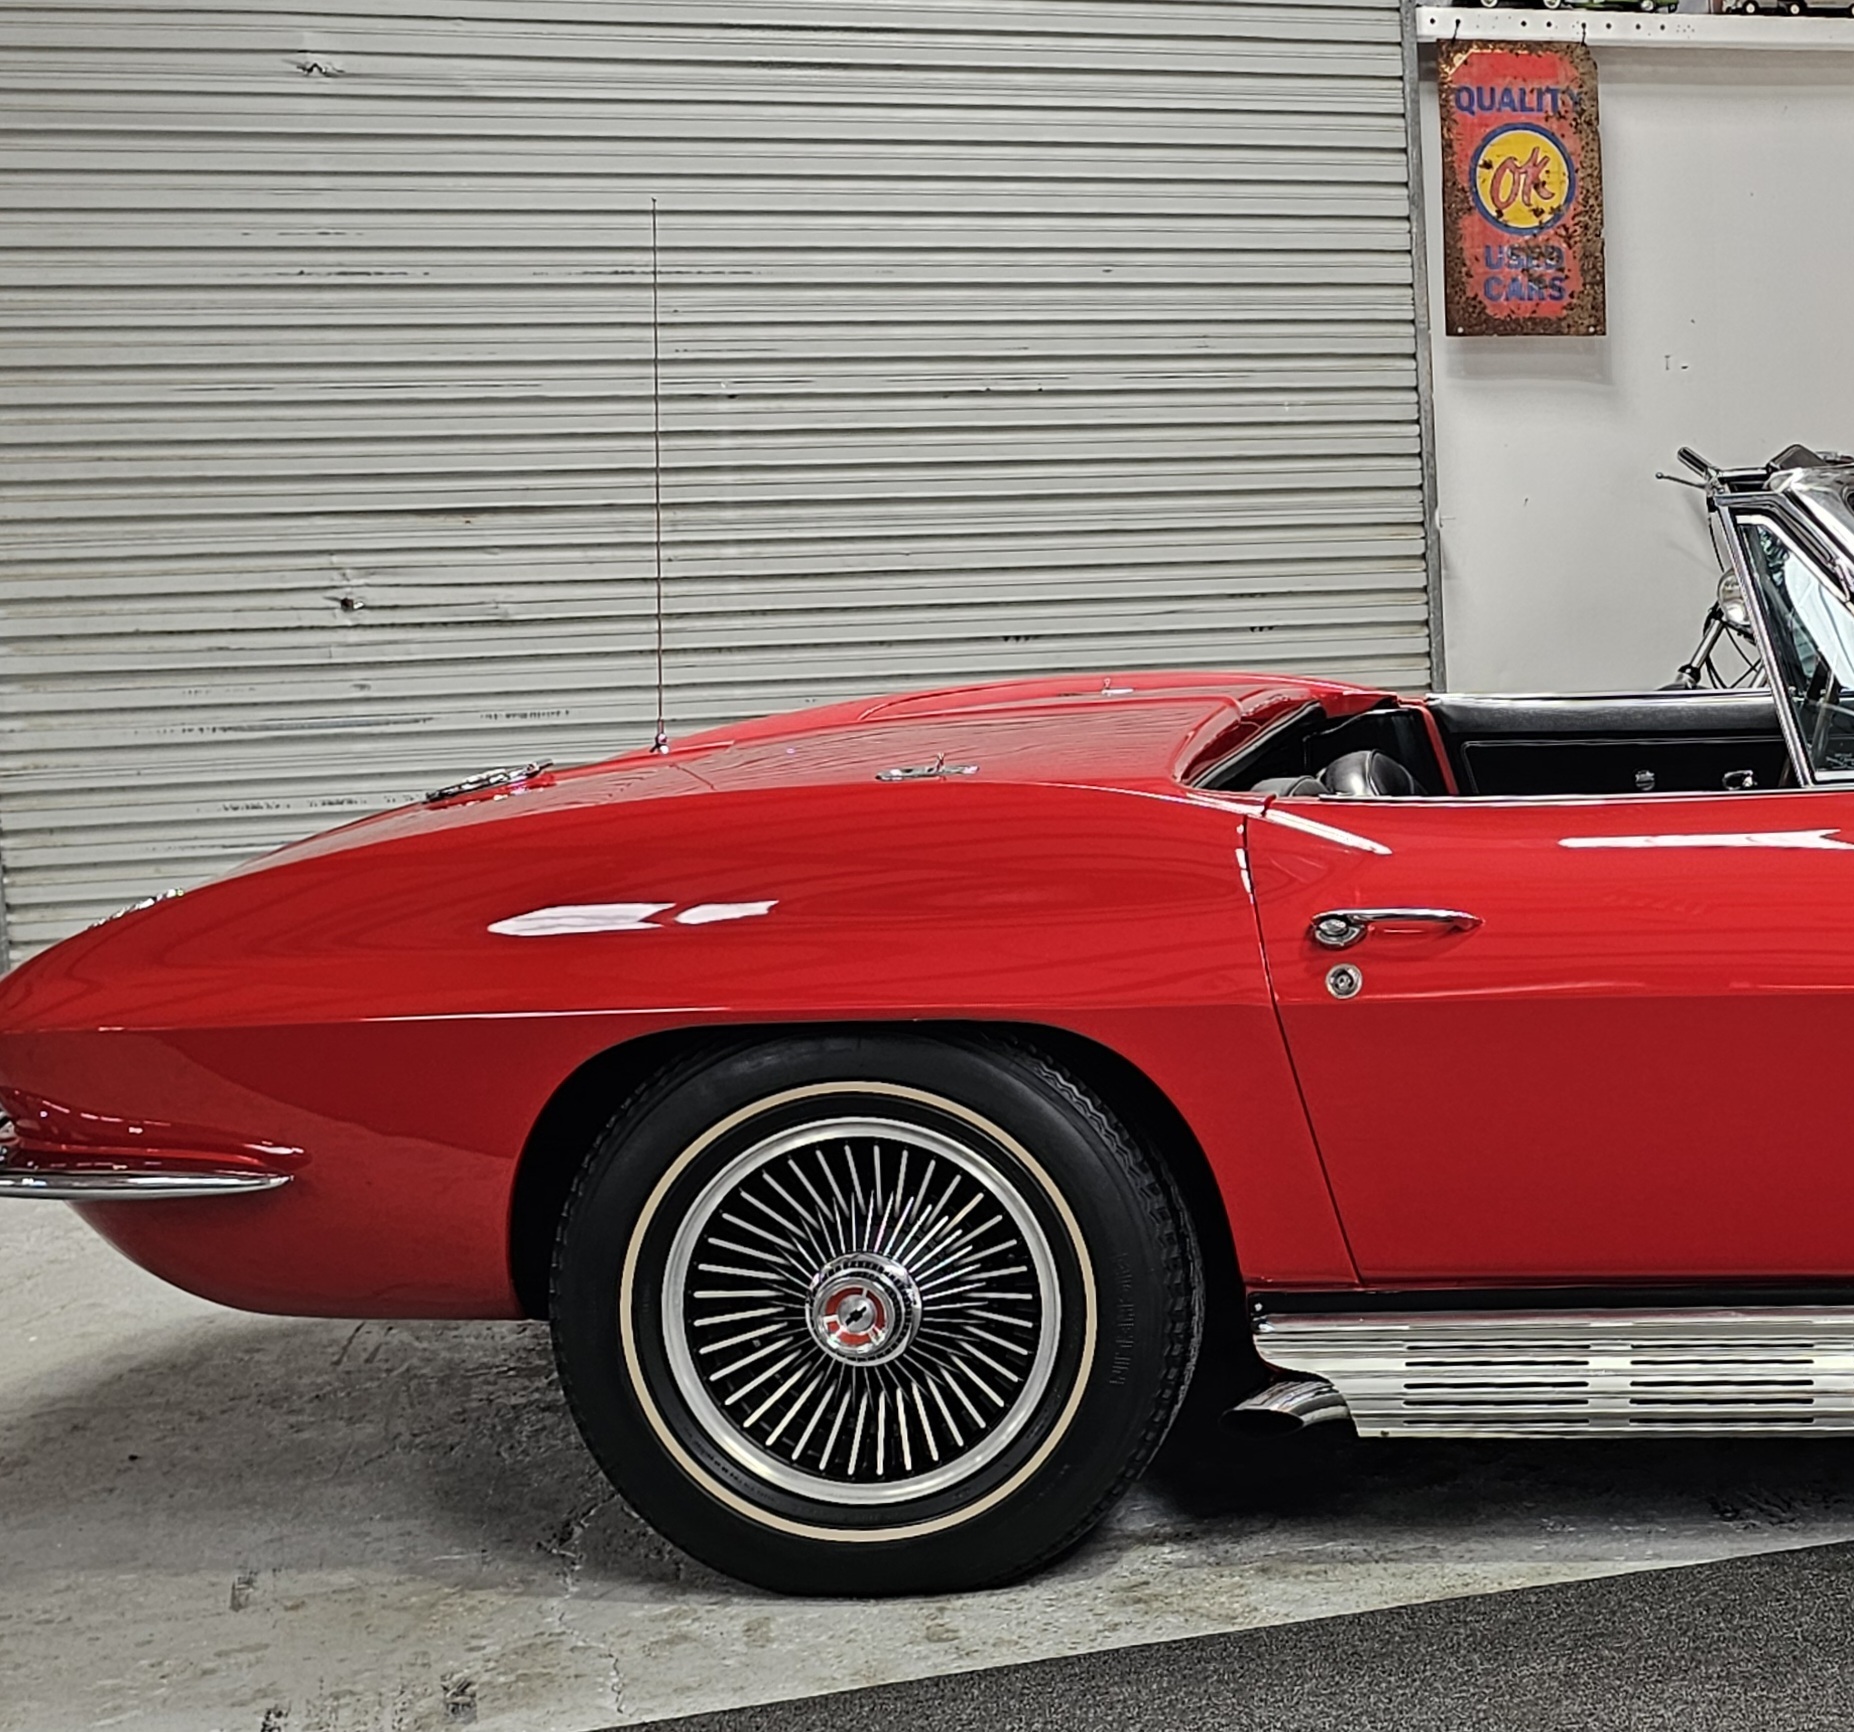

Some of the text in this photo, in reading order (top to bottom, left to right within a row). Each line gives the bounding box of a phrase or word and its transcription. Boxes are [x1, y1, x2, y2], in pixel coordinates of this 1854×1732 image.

[1455, 85, 1582, 116] QUALITY
[1490, 146, 1555, 210] OK
[1485, 244, 1565, 271] USED
[1484, 276, 1566, 302] CARS
